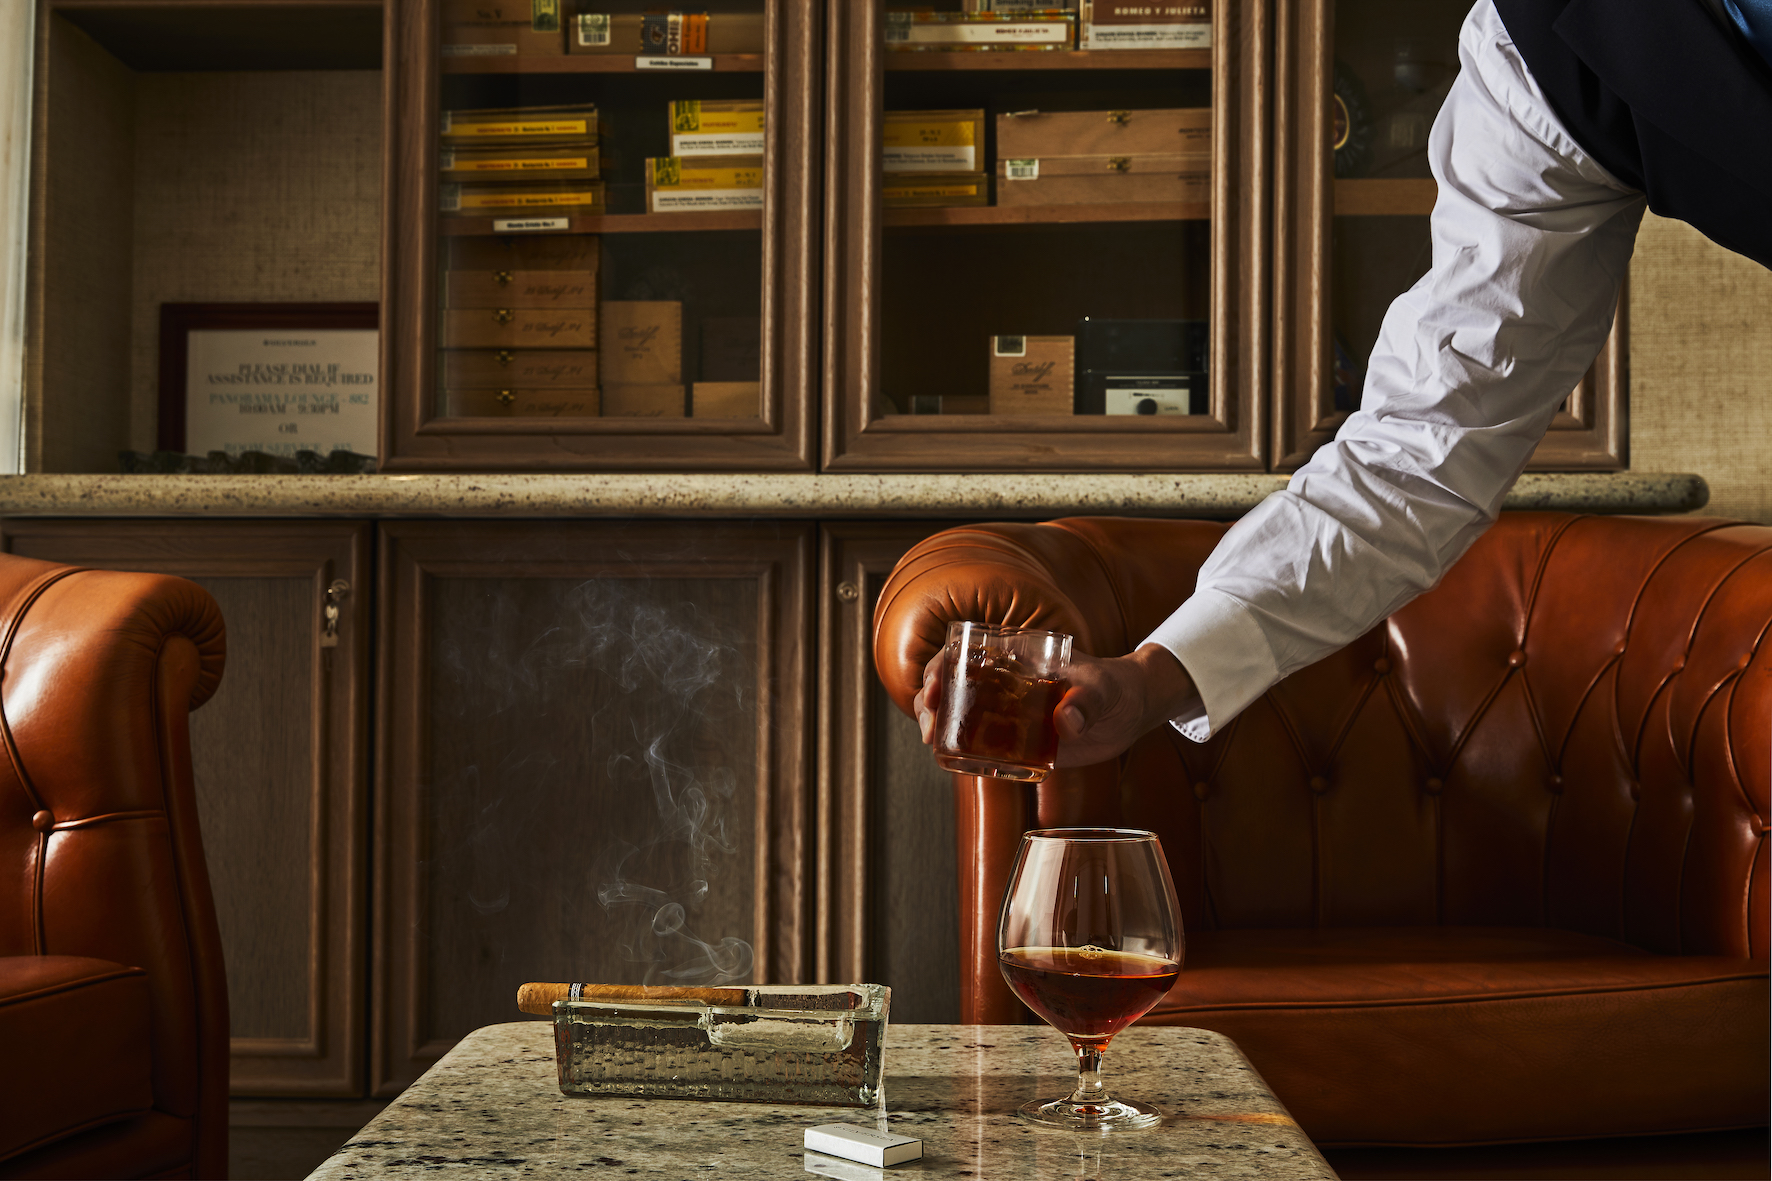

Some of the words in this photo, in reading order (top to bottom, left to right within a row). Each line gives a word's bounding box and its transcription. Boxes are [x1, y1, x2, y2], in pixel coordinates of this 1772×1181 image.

[1114, 7, 1152, 16] ROMEO
[1154, 7, 1162, 15] Y
[1165, 6, 1206, 15] JULIETA
[239, 363, 290, 375] PLEASE
[208, 373, 288, 385] ASSISTANCE
[289, 374, 302, 385] IS
[304, 373, 374, 387] REQUIRED
[209, 393, 282, 405] PANORAMA
[278, 423, 299, 434] OR
